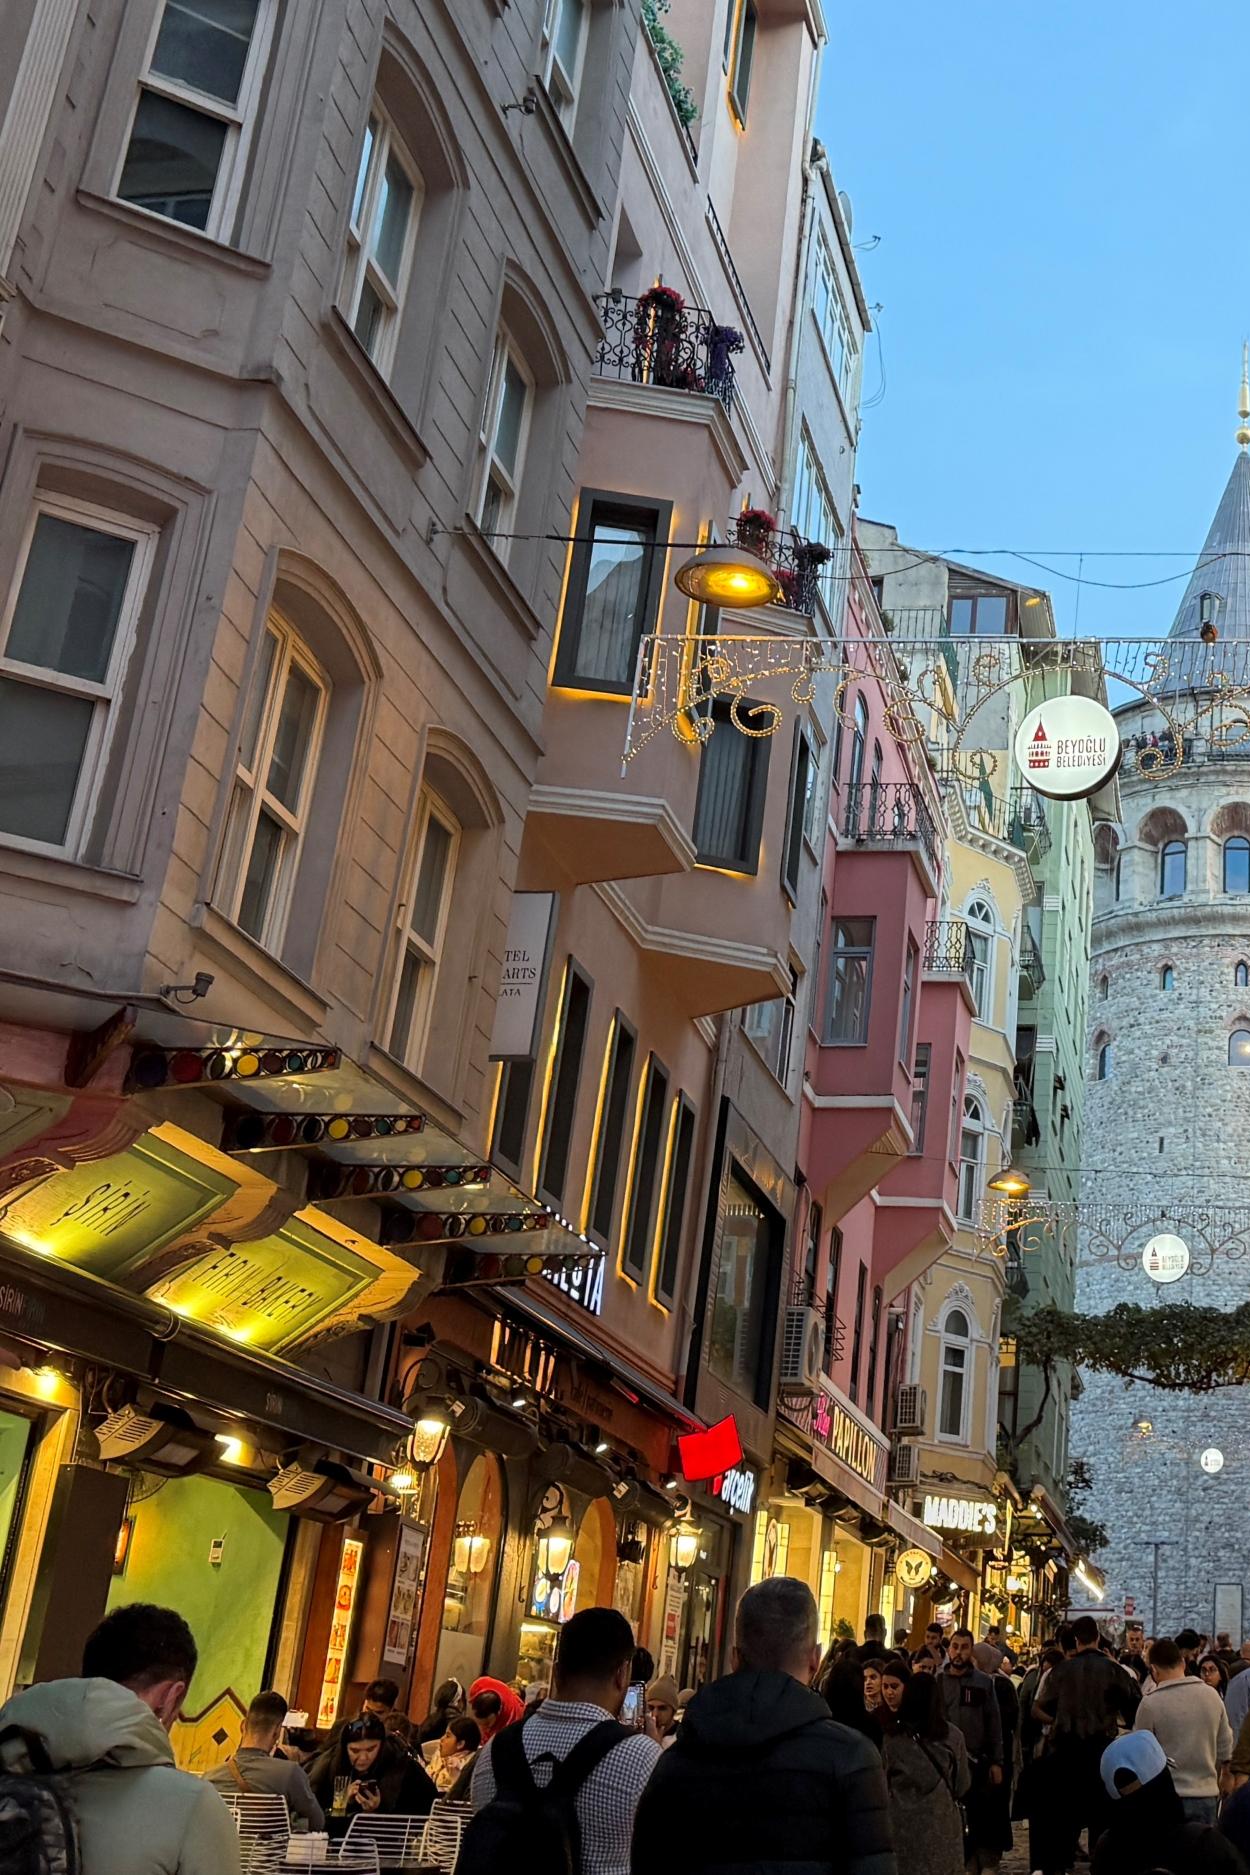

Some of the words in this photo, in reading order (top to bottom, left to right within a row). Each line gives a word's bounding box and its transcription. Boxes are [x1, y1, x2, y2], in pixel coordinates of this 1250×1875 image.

[1056, 753, 1106, 768] BELEDİYESİ
[1057, 735, 1106, 755] BEYOĞLU
[505, 950, 530, 962] TEL
[49, 1180, 152, 1237] ŞİRİN
[241, 1276, 325, 1326] BAKERY
[831, 1405, 877, 1484] PAPILLON
[923, 1495, 997, 1535] MADDIE'S
